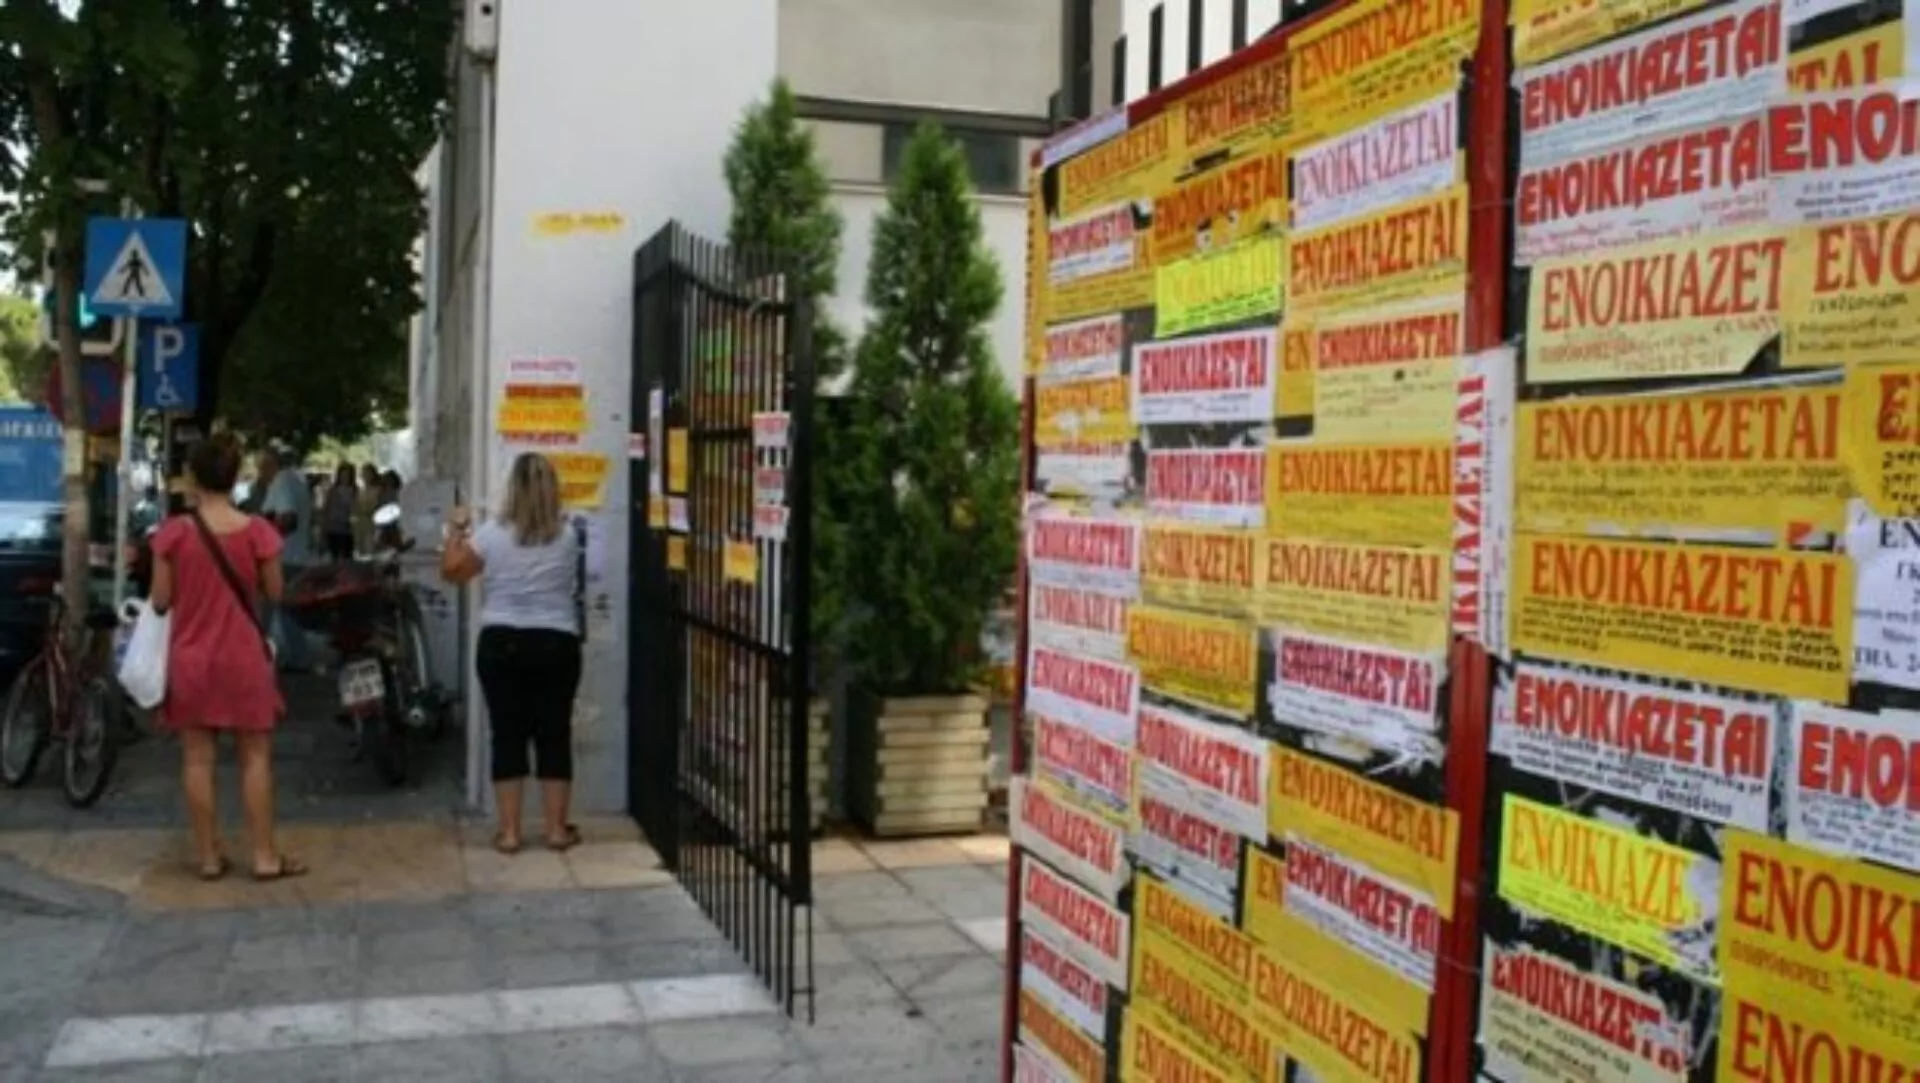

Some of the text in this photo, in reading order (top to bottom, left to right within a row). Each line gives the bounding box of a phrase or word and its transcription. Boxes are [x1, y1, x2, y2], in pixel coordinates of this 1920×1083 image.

[1524, 2, 1780, 131] ΕΝΟΙΚΙΑΖΕΤΑΙ
[1787, 41, 1881, 92] ΤΑΙ
[1299, 102, 1452, 206] ΕΝΟΙΚΙΑΖΕΤΑΙ
[1769, 92, 1918, 172] ΕΝΟΙ
[1291, 197, 1459, 297] ΕΝΟΙΚΙΑΖΕΤΑΙ
[1543, 238, 1786, 332] ΕΝΟΙΚΙΑΖΕΤ
[154, 327, 184, 372] P
[1139, 336, 1267, 394] ΕΝΟΙΚΙΑΖΕΤΑΙ
[1319, 313, 1459, 369] ΕΝΟΙΚΙΑΖΕΤΑΙ
[1533, 394, 1841, 463] ΕΝΟΙΚΙΑΖΕΤΑΙ
[1279, 447, 1451, 496] ΕΝΟΙΚΙΑΖΕΤΑΙ
[1269, 542, 1440, 602] ΕΝΟΙΚΙΑΖΕΤΑΙ
[1532, 540, 1836, 629] ΕΝΟΙΚΙΑΖΕΤΑΙ
[1282, 636, 1432, 712] ΕΝΟΙΚΙΑΖΕΤΑΙ
[1516, 674, 1768, 778] ΕΝΟΙΚΙΑΖΕΤΑΙ
[1278, 754, 1447, 864] ΕΝΟΙΚΙΑΖΕΤΑΙ
[1286, 840, 1437, 955] ΕΝΟΙΚΙΑΖΕΤΑΙ
[1509, 803, 1686, 925] ΕΝΟΙΚΙΑΖΕ
[1733, 1000, 1920, 1083] ΕΝΟΙ
